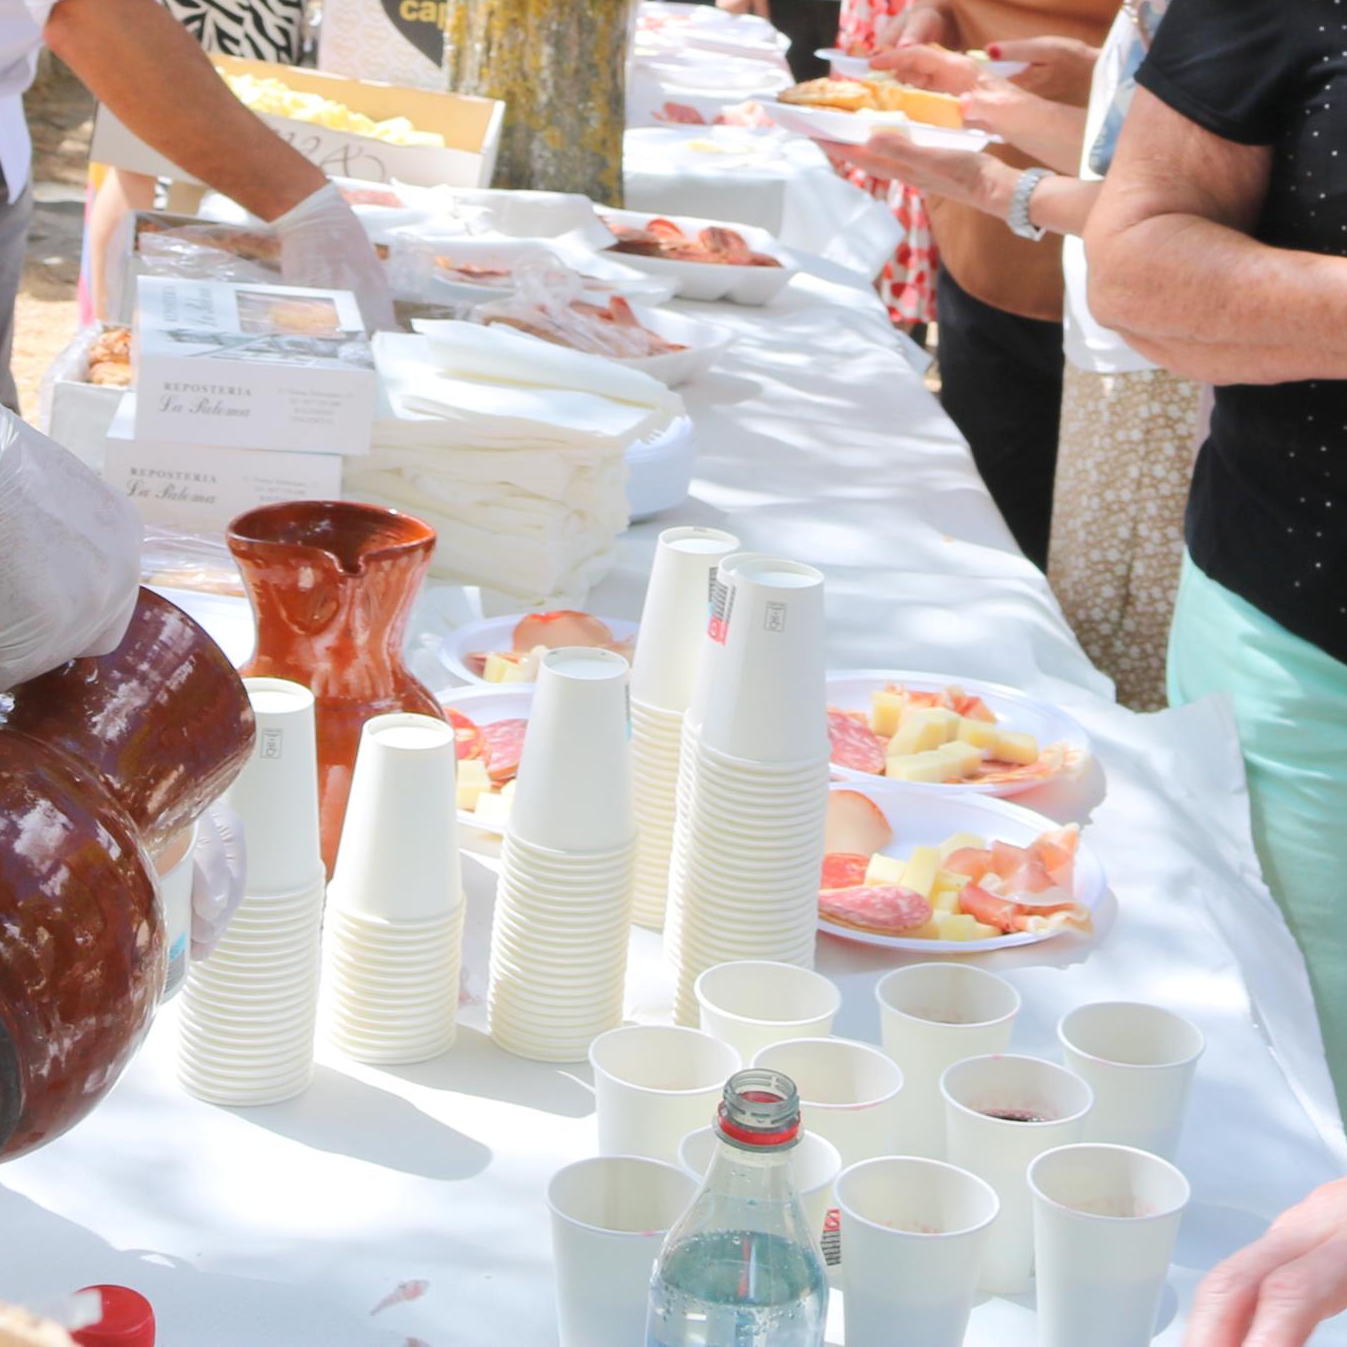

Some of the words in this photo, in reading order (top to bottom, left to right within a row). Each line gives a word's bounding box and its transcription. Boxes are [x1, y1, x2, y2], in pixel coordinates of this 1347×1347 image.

[163, 381, 252, 396] REPOSTERIA
[158, 395, 182, 412] La
[188, 397, 252, 418] Paloma
[130, 467, 218, 483] REPOSTERIA
